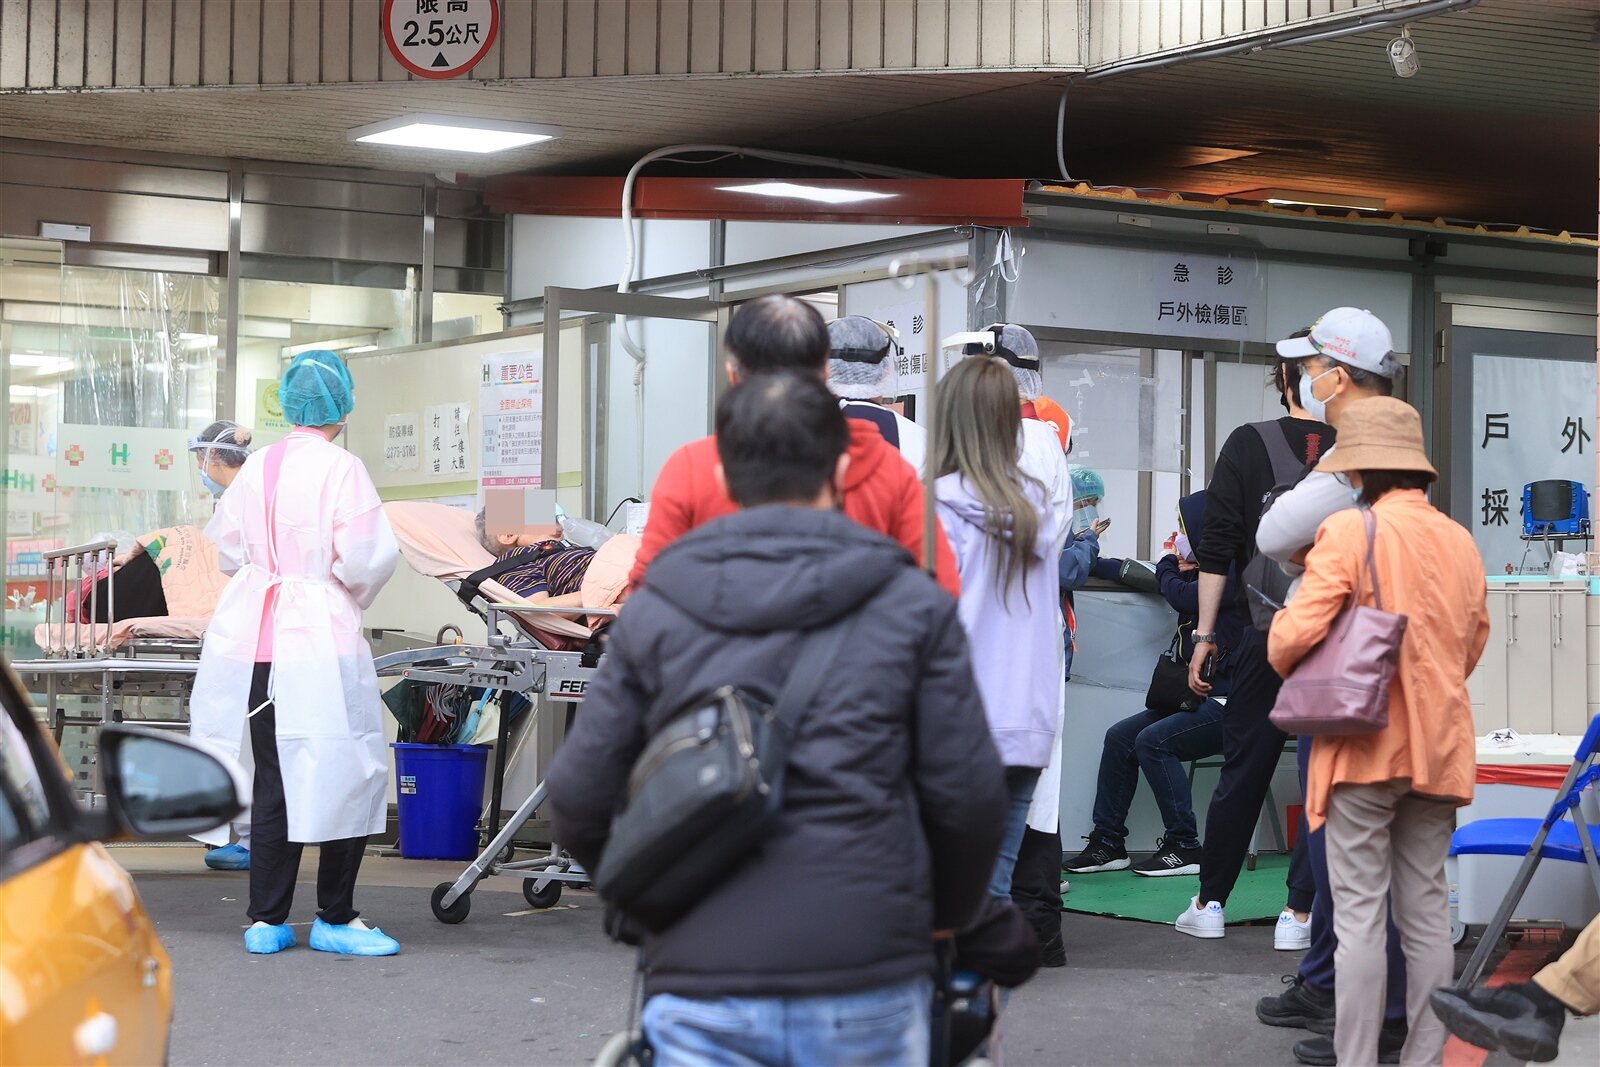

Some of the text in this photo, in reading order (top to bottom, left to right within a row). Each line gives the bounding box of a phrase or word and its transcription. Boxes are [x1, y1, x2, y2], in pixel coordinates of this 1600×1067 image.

[403, 20, 480, 47] 2.5公尺
[1158, 301, 1248, 326] 戶外檢傷區
[500, 363, 534, 381] 重要公告
